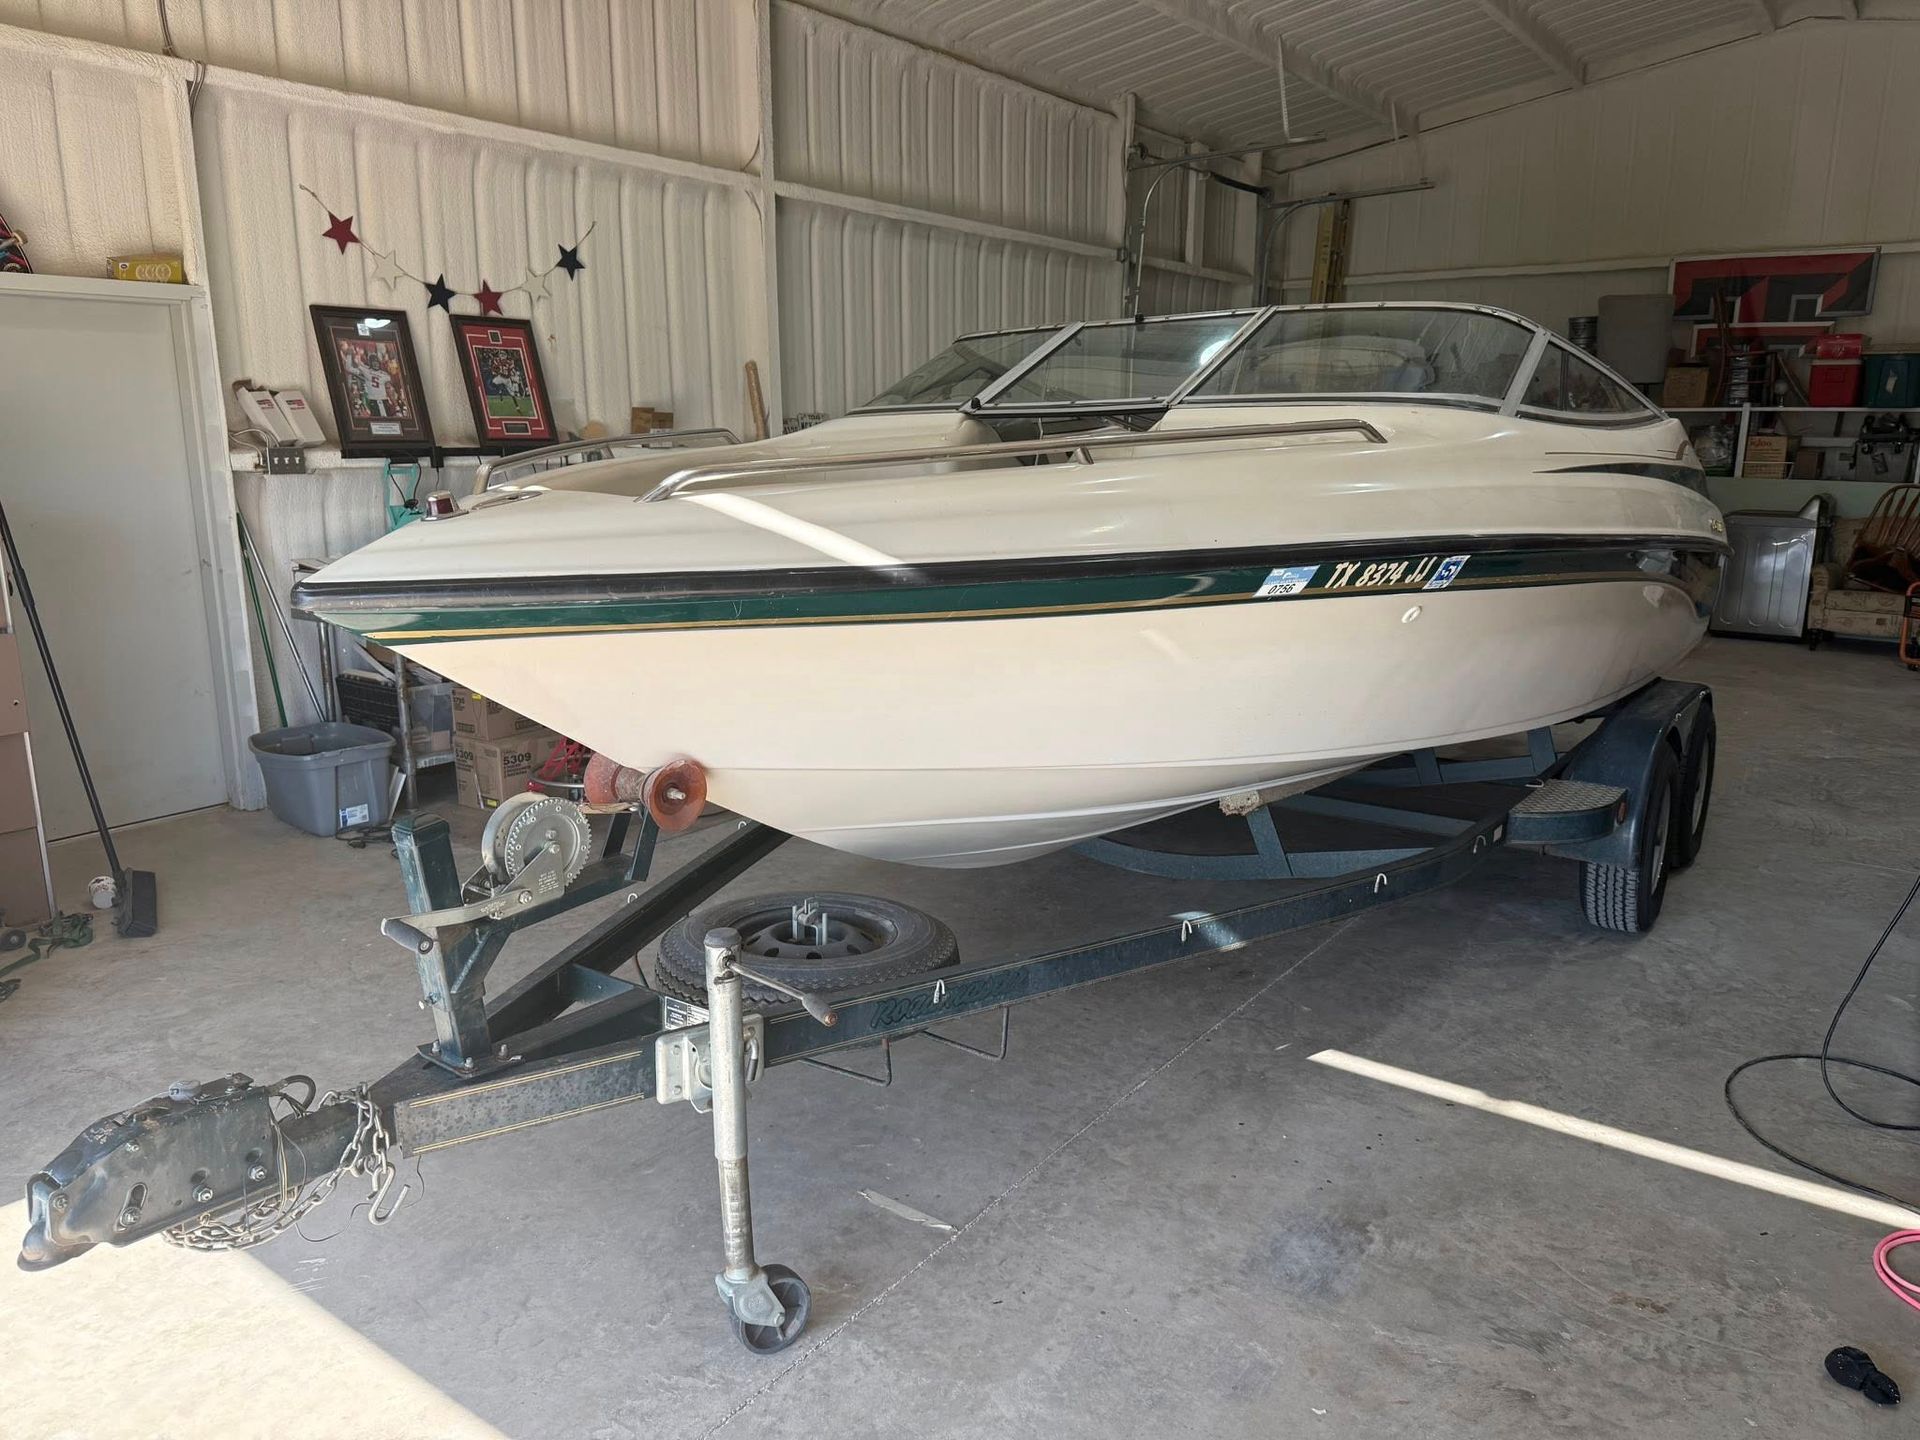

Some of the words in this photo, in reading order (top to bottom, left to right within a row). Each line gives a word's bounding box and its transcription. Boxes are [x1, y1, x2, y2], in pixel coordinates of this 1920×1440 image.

[371, 376, 380, 389] 5
[1324, 561, 1361, 589] TX
[1355, 561, 1409, 587] 8374
[1267, 583, 1296, 595] 0756
[503, 752, 532, 765] 5309
